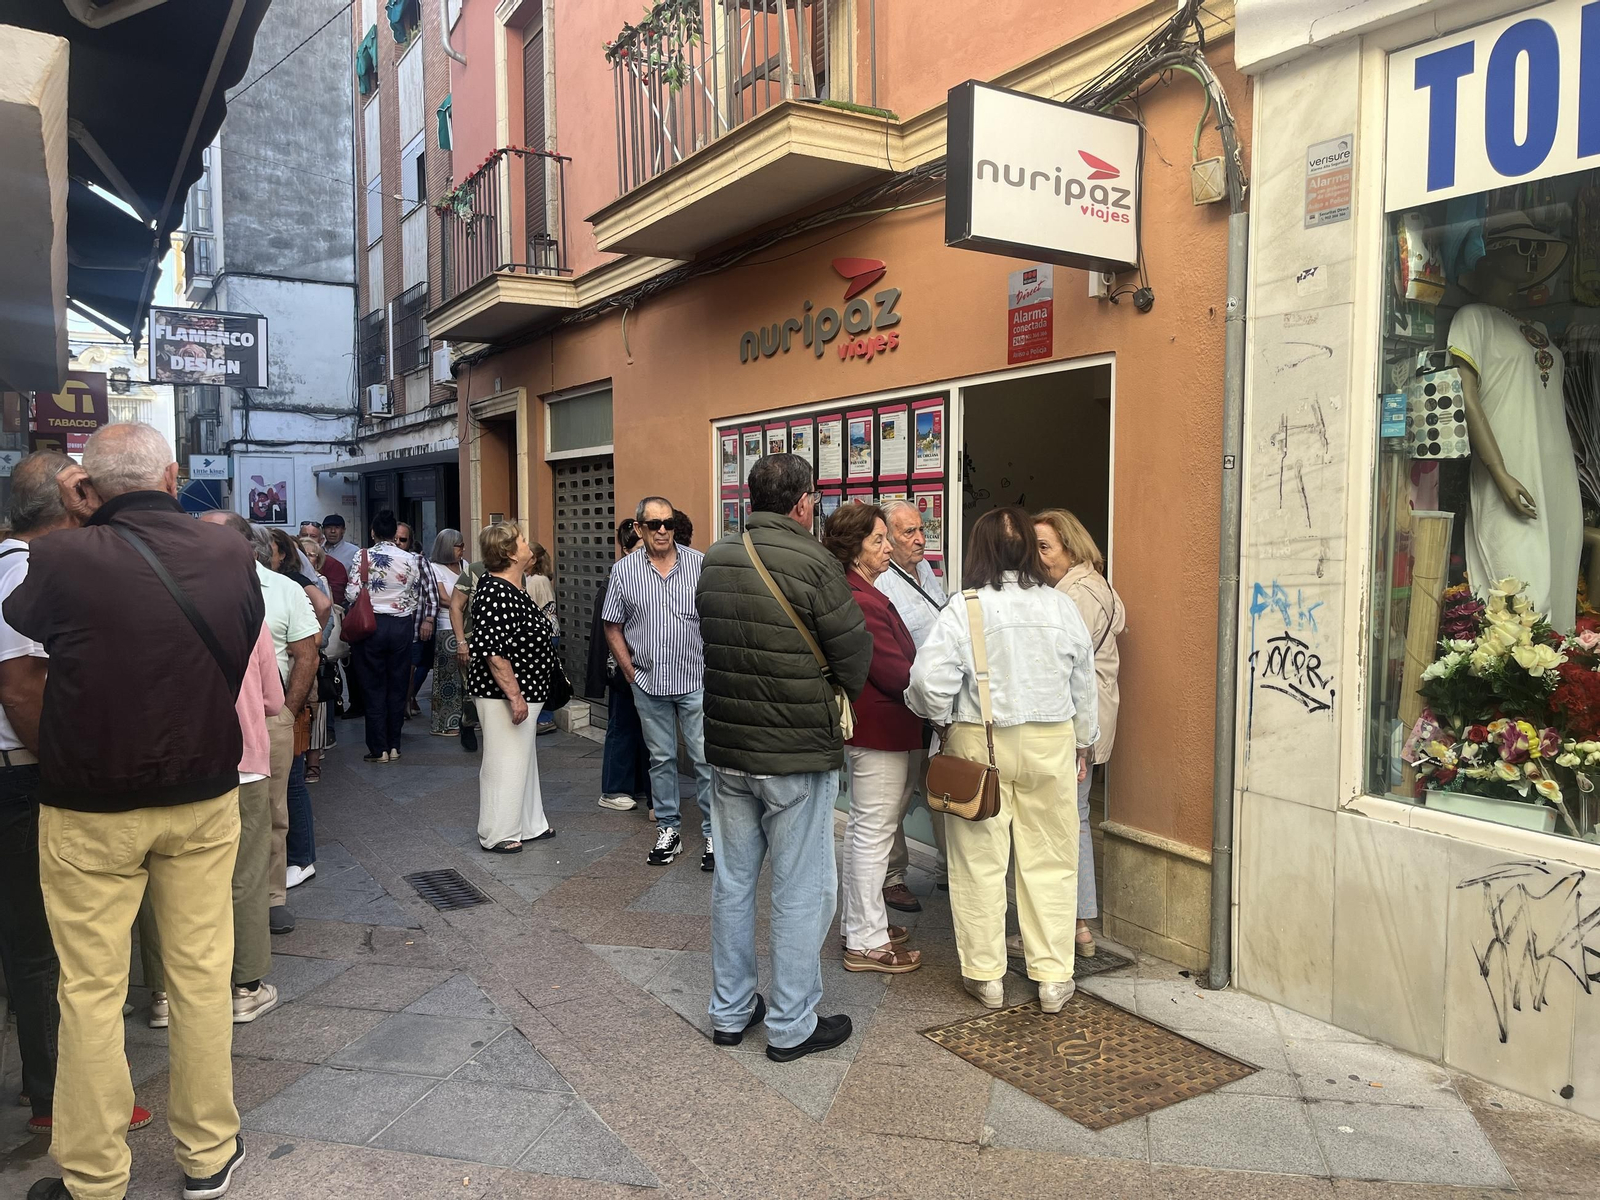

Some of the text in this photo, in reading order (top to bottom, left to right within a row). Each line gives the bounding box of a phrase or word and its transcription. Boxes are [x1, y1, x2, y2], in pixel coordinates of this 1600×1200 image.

[976, 159, 1131, 210] nuripaz
[1309, 174, 1350, 189] Alarma
[1080, 203, 1130, 224] viajes
[739, 287, 902, 364] nuripaz
[1013, 307, 1047, 324] Alarma
[155, 324, 255, 347] FLAMENCO
[1013, 319, 1047, 334] conectada
[837, 331, 900, 361] viajes
[170, 356, 241, 375] DESIGN
[48, 418, 97, 428] TABACOS
